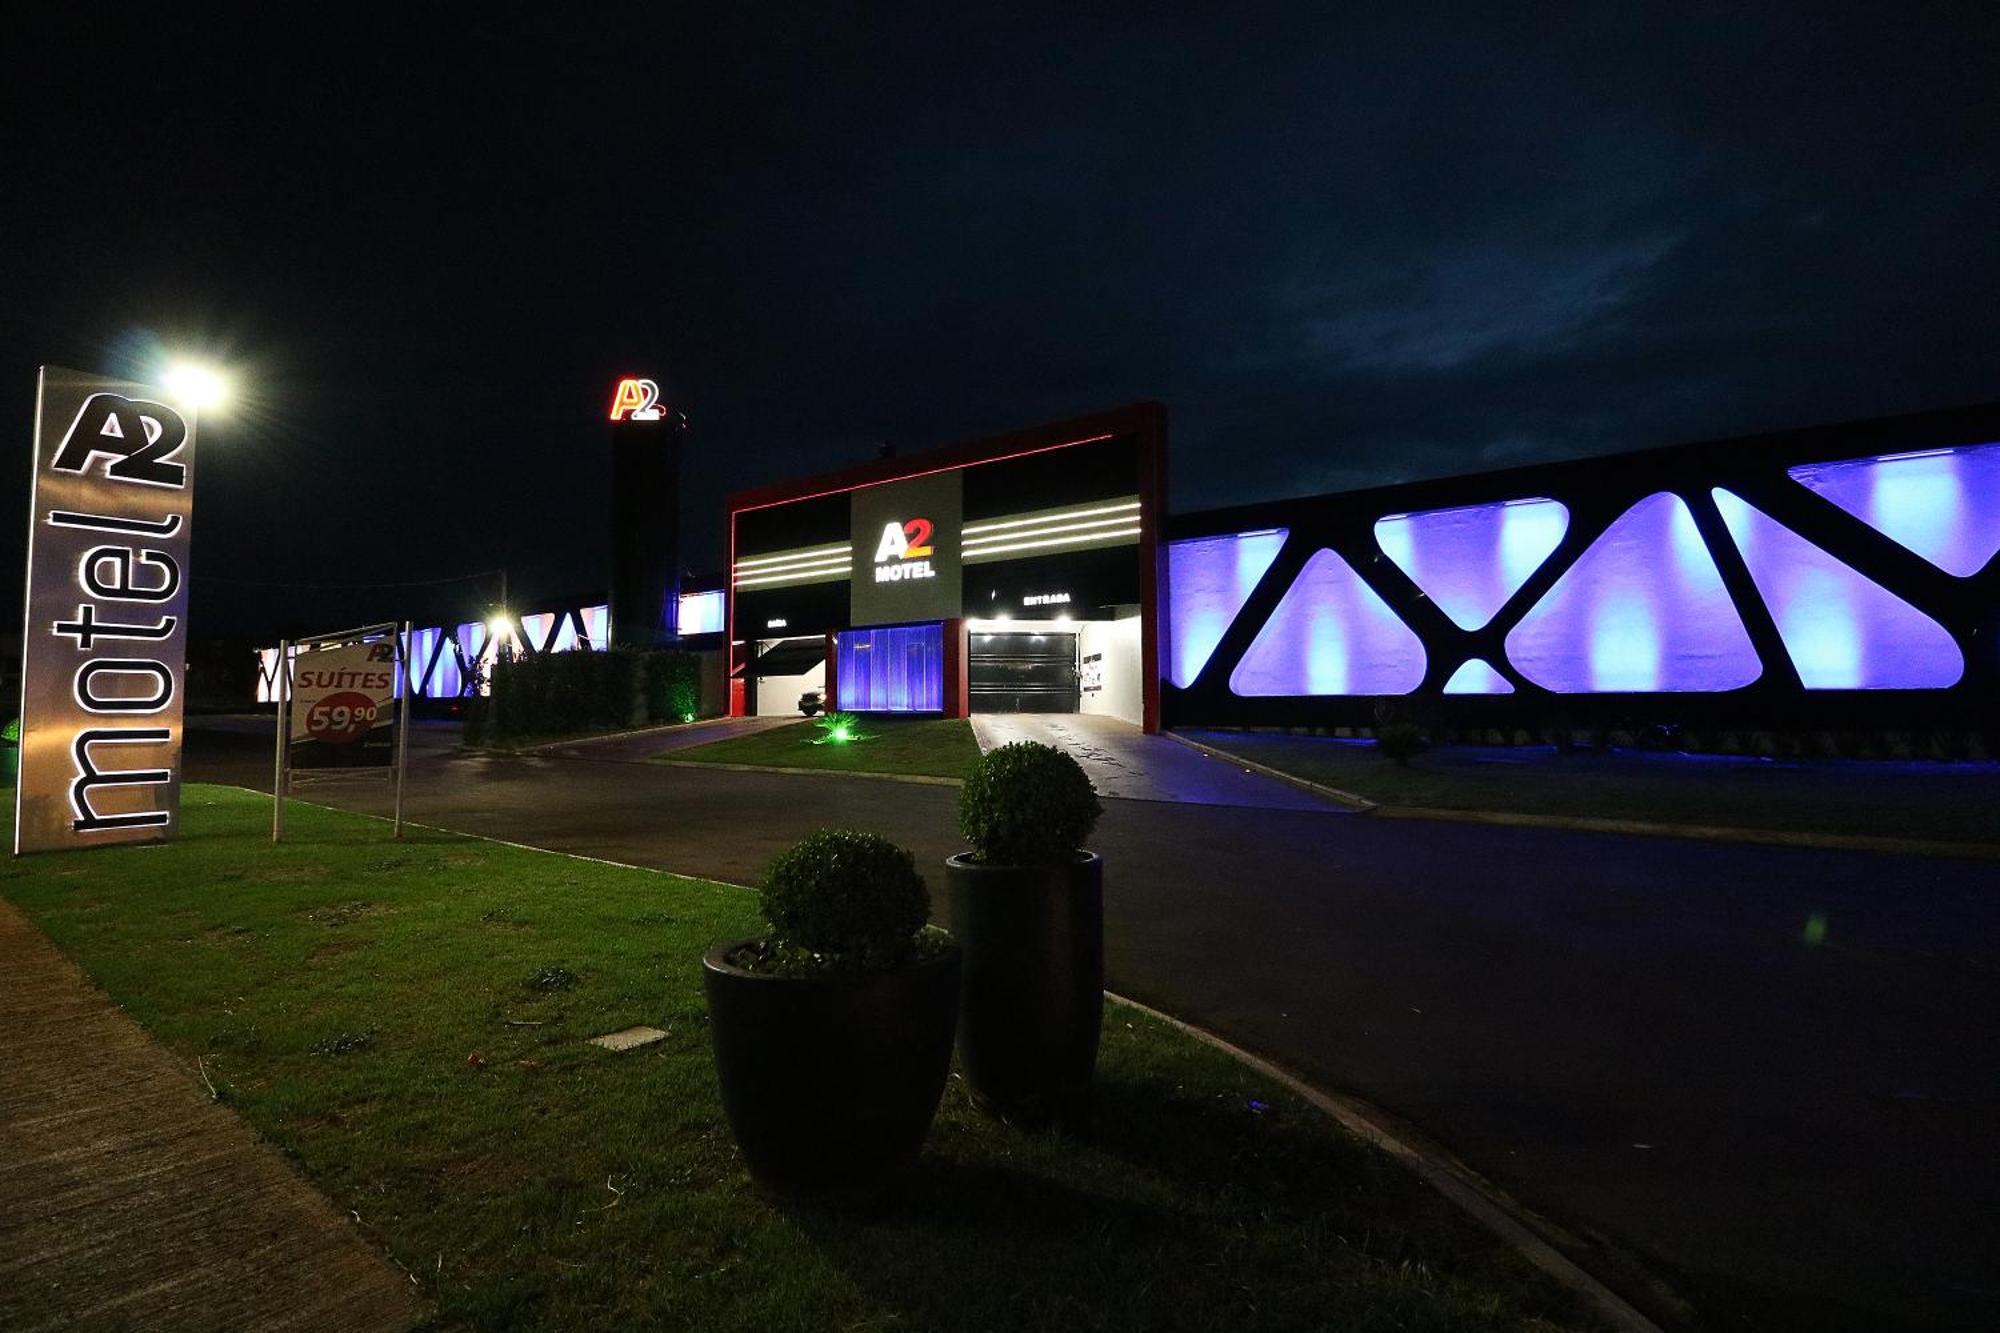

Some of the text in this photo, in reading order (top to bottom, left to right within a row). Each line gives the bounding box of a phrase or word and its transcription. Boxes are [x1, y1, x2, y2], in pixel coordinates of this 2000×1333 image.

[610, 379, 660, 420] A2
[53, 393, 187, 488] A2
[874, 518, 934, 562] A2
[875, 560, 936, 583] MOTEL
[1023, 593, 1071, 605] ENTRADA
[366, 643, 394, 662] A2
[48, 510, 184, 832] motel
[298, 667, 391, 688] SUÍTES
